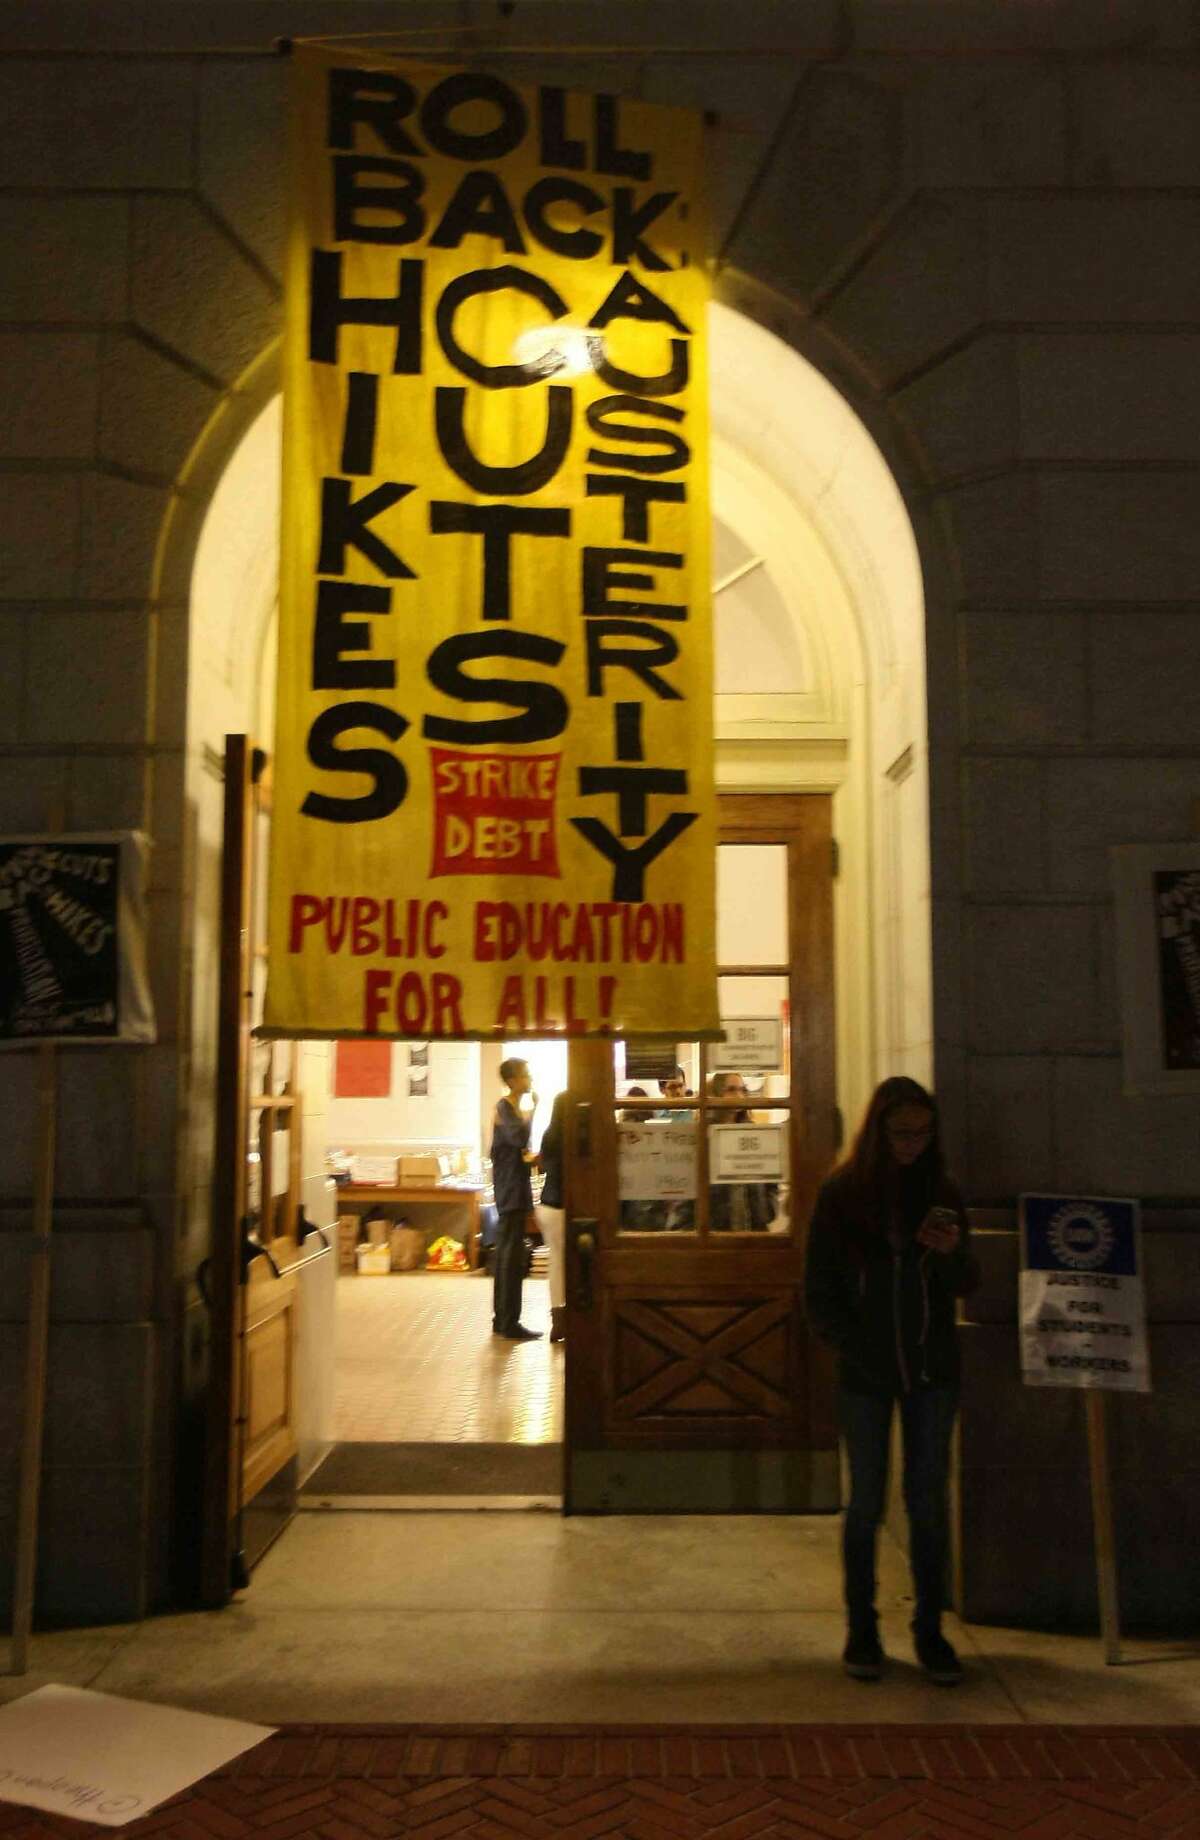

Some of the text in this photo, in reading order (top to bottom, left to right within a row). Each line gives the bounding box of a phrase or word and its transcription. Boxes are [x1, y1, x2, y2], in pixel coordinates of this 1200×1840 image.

[326, 69, 650, 179] ROLL
[300, 248, 425, 823] HIKES
[421, 264, 573, 744] CUTS
[567, 270, 700, 902] AUSTERITY
[438, 758, 556, 800] STRIKE
[444, 814, 550, 862] DEBT
[288, 894, 686, 964] PUBLIC EDUCATION
[363, 969, 620, 1036] FOR ALL!
